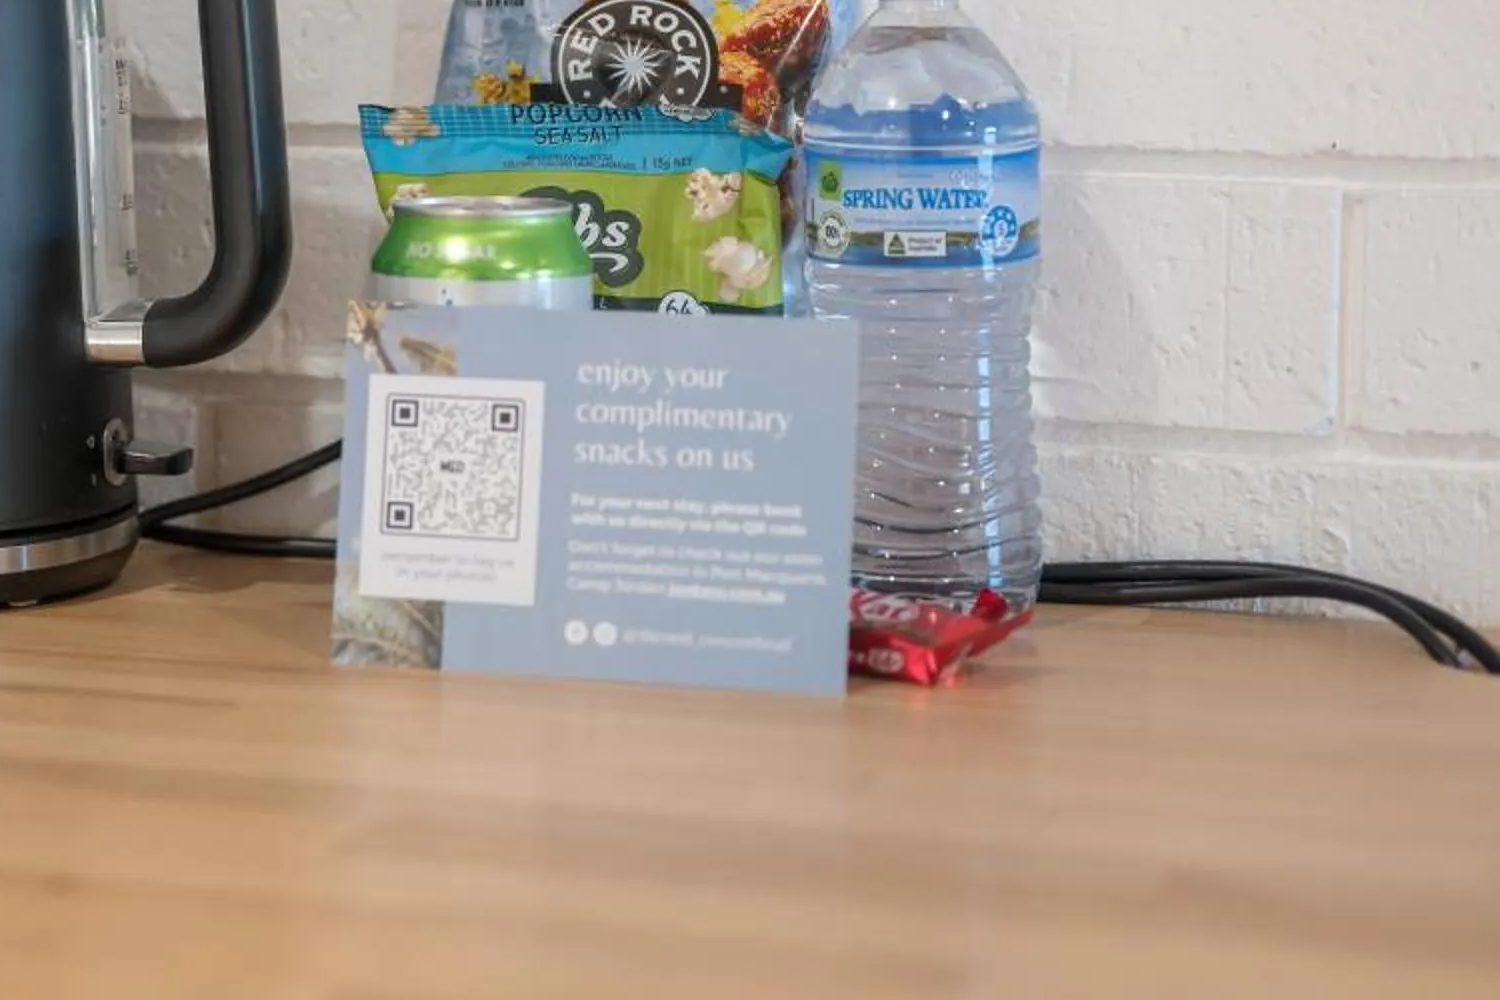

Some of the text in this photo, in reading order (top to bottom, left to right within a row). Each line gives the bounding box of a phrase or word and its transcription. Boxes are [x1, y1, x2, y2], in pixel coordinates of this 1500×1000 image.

[567, 5, 702, 81] RED ROCK
[511, 102, 643, 125] POPCORN
[534, 125, 624, 146] SEA SALT
[842, 187, 988, 211] SPRING WATER
[576, 357, 730, 395] enjoy your
[574, 398, 793, 441] complimentary
[573, 437, 755, 472] snacks on us
